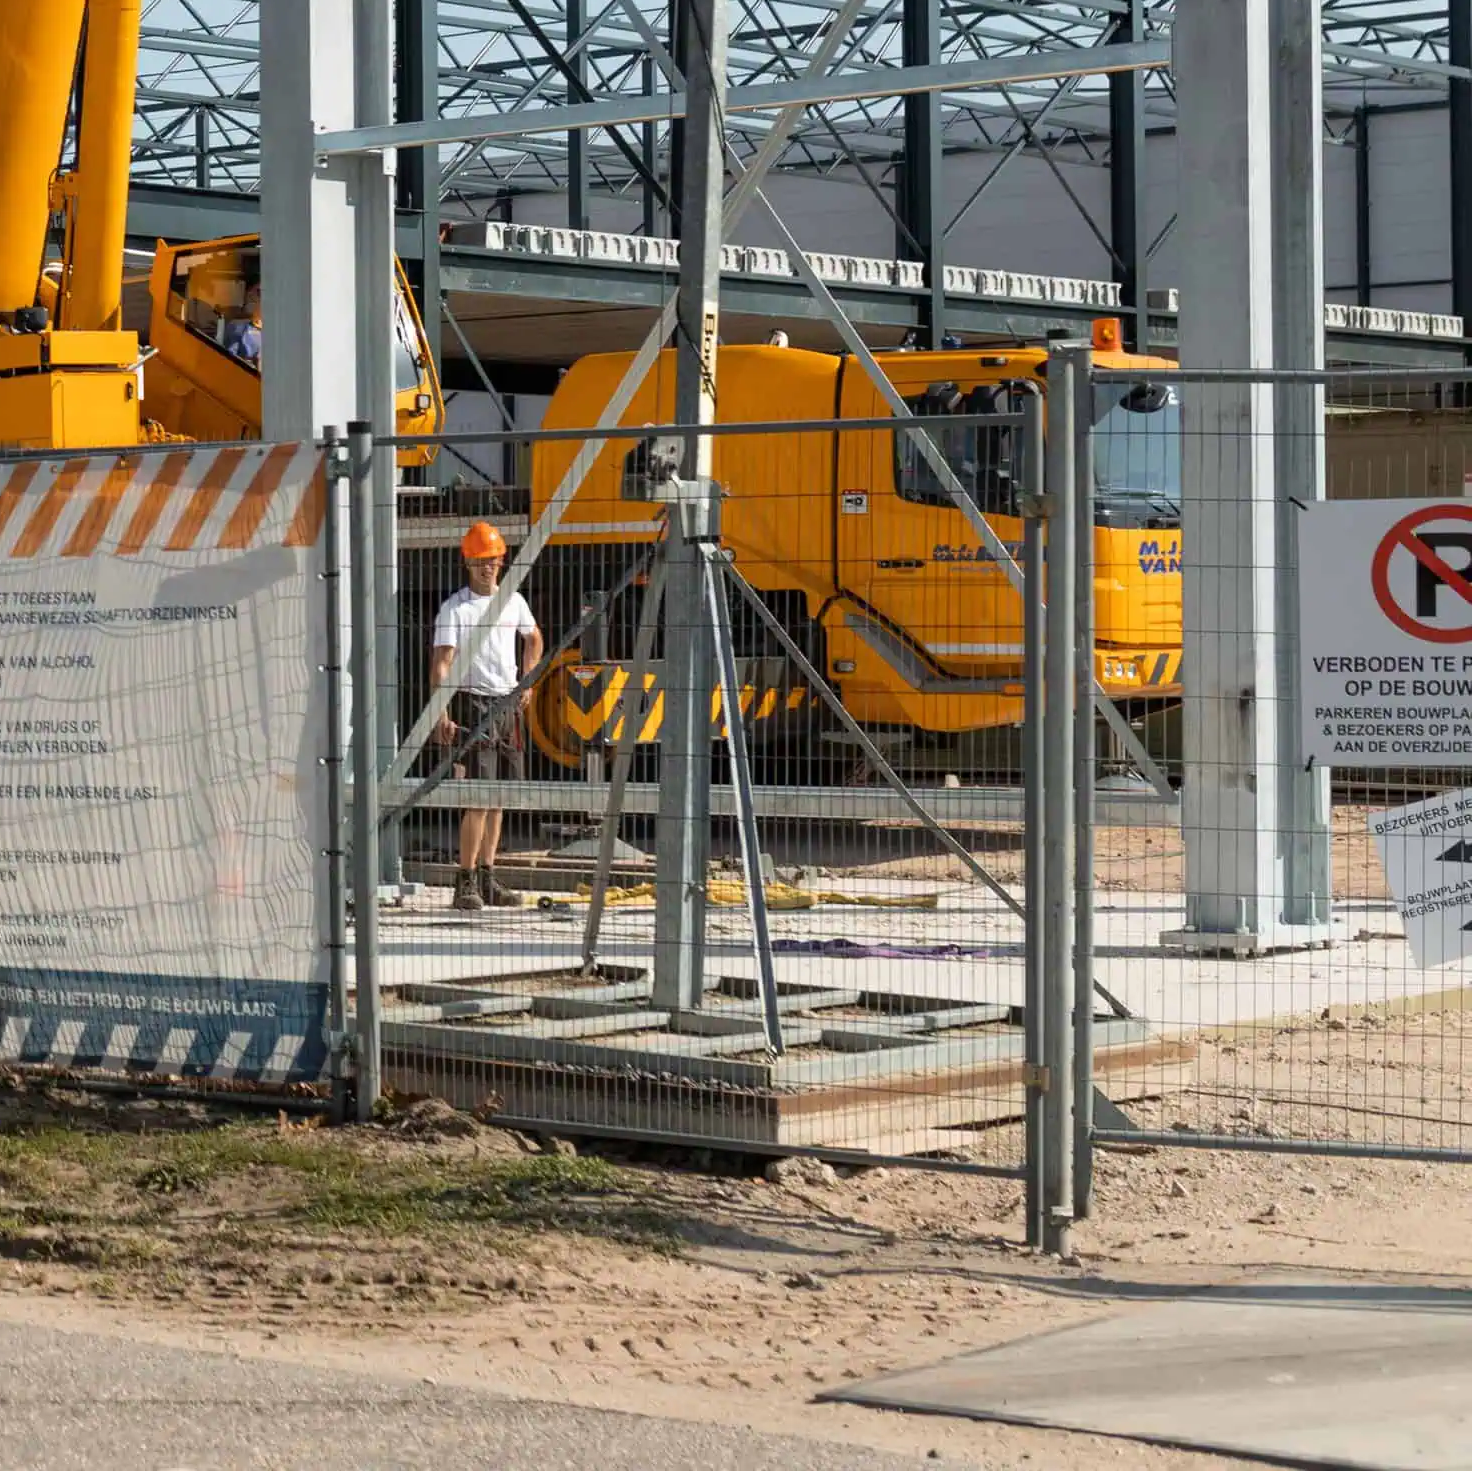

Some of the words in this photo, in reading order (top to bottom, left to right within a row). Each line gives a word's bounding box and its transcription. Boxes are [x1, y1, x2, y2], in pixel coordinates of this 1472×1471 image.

[1139, 558, 1184, 575] VAN
[11, 591, 97, 606] TOEGESTAAN
[84, 605, 238, 624] SCHAFTVOORZIENINGEN
[9, 655, 38, 670] VAN
[1312, 656, 1424, 673] VERBODEN
[1431, 656, 1456, 672] TE
[1345, 680, 1373, 696] OP
[1379, 680, 1406, 696] DE
[1412, 680, 1472, 696] BOUW
[1315, 707, 1393, 720] PARKEREN
[1323, 725, 1333, 737] &
[1337, 724, 1425, 736] BEZOEKERS
[1428, 724, 1449, 736] OP
[1453, 724, 1472, 736] PA
[1334, 741, 1364, 753] AAN
[1368, 741, 1388, 753] DE
[1391, 741, 1472, 753] OVERZIJDE
[16, 785, 41, 800] EEN
[44, 785, 121, 801] HANGENDE
[1375, 805, 1450, 835] BEZOEKERS
[173, 997, 277, 1017] BOUWPLAATS
